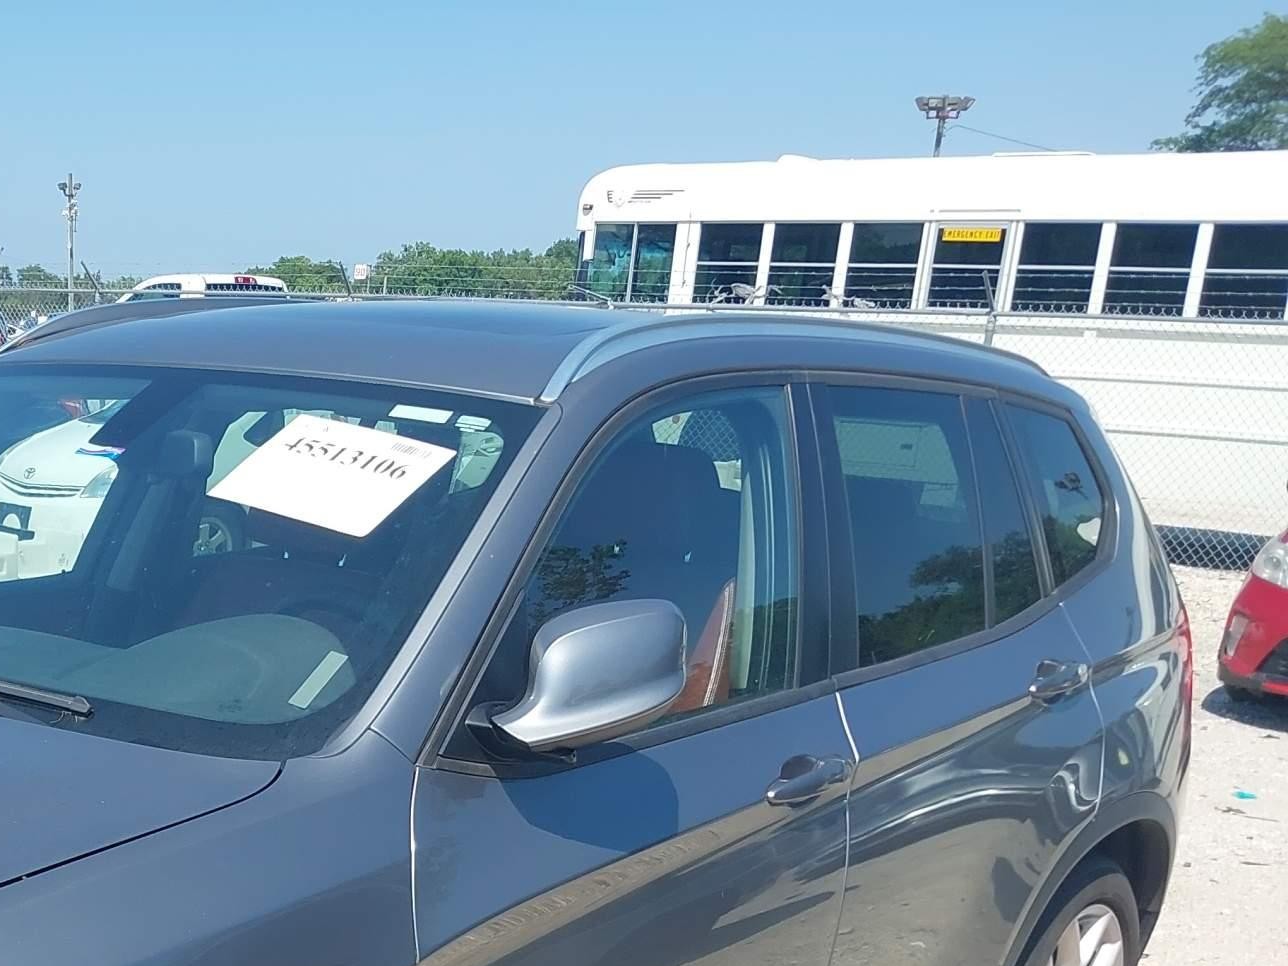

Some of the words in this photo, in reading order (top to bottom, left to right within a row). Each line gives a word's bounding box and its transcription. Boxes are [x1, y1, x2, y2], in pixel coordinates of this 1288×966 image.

[943, 229, 983, 239] EMERGENCY
[985, 230, 1000, 240] EXIT
[284, 436, 407, 481] 45513106
